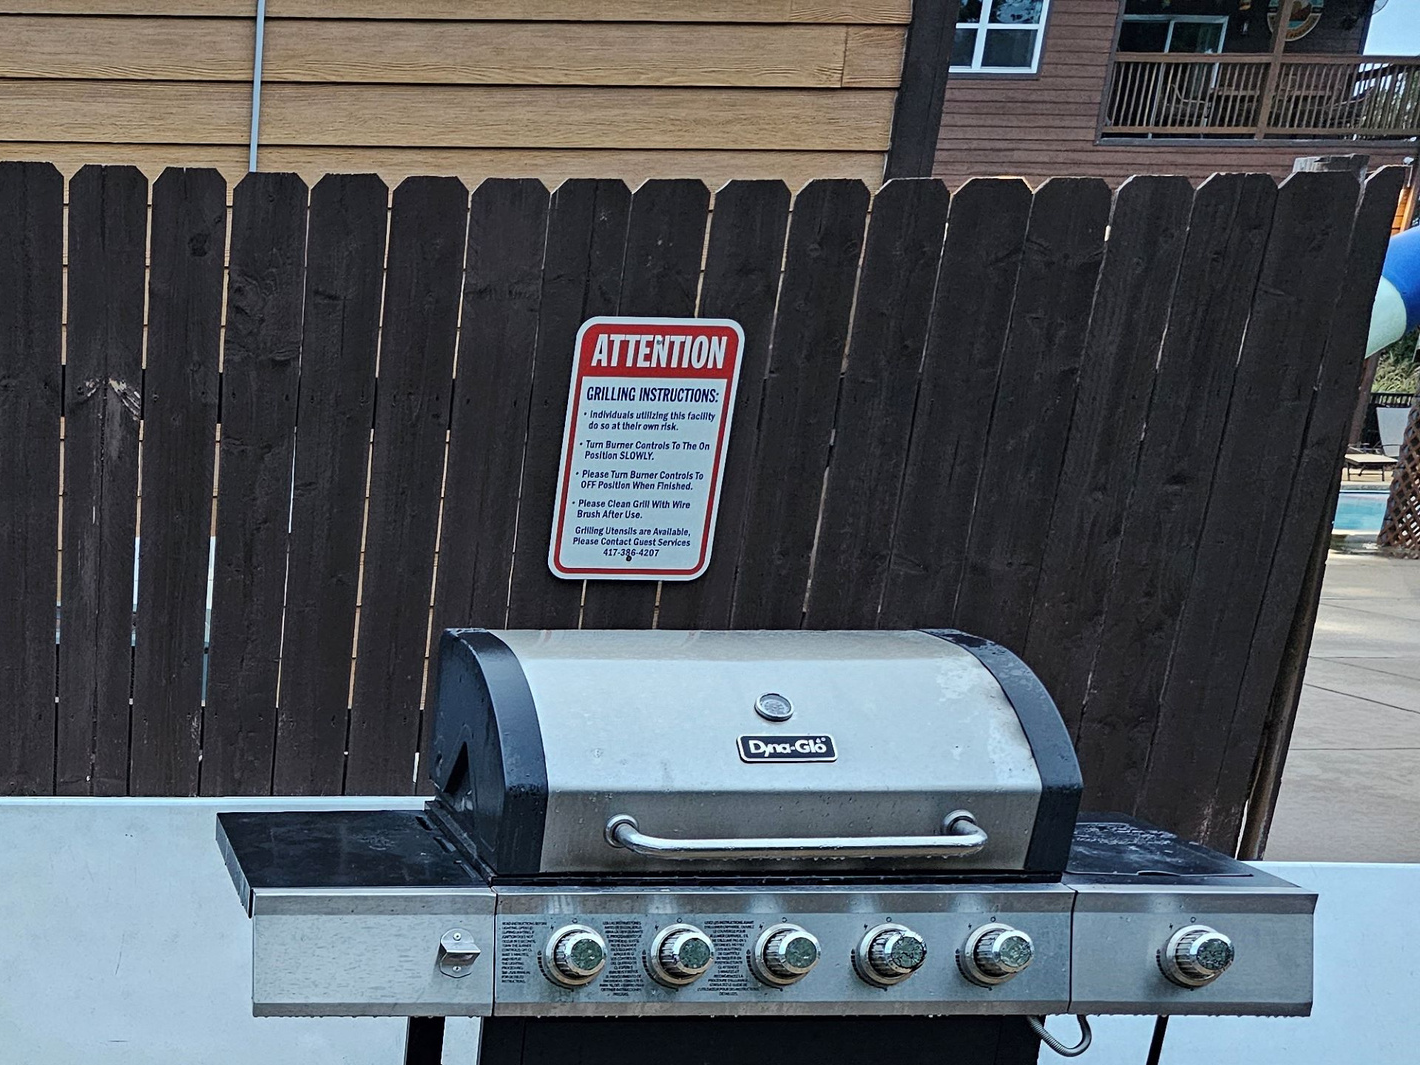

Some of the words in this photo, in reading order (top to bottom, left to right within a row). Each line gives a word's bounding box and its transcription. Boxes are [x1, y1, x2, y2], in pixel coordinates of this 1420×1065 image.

[591, 334, 728, 369] ATTENTION
[587, 386, 636, 402] GRILLING
[639, 387, 720, 403] INSTRUCTIONS:
[589, 410, 634, 419] Individuals
[636, 411, 669, 421] utilizing
[670, 411, 686, 420] this
[687, 411, 716, 422] facility
[588, 421, 598, 430] do
[611, 422, 620, 430] at
[622, 421, 642, 430] their
[642, 423, 659, 431] own
[660, 422, 679, 431] risk.
[585, 440, 604, 449] Turn
[605, 440, 633, 449] Burner
[635, 441, 670, 450] Controls
[672, 441, 681, 450] To
[682, 441, 697, 450] The
[698, 442, 710, 451] On
[584, 450, 618, 460] Position
[619, 451, 655, 461] SLOWLY.
[582, 469, 609, 479] Please
[611, 470, 628, 479] Turn
[629, 470, 658, 479] Burner
[659, 471, 693, 480] Controls
[695, 471, 704, 480] To
[580, 480, 597, 489] OFF
[598, 480, 630, 490] Position
[632, 481, 655, 490] When
[656, 482, 693, 491] Finished.
[578, 499, 605, 508] Please
[607, 499, 631, 508] Clean
[632, 500, 650, 508] Grill
[652, 500, 670, 509] With
[672, 500, 691, 509] Wire
[576, 509, 601, 518] Brush
[602, 510, 623, 519] After
[624, 510, 643, 519] Use.
[575, 526, 604, 536] Grilling
[605, 527, 637, 536] Utensils
[638, 528, 652, 536] are
[652, 527, 691, 537] Available,
[572, 537, 599, 545] Please
[600, 537, 632, 546] Contact
[633, 538, 656, 546] Guest
[657, 538, 691, 547] Services
[749, 738, 826, 757] Dyna-Glo
